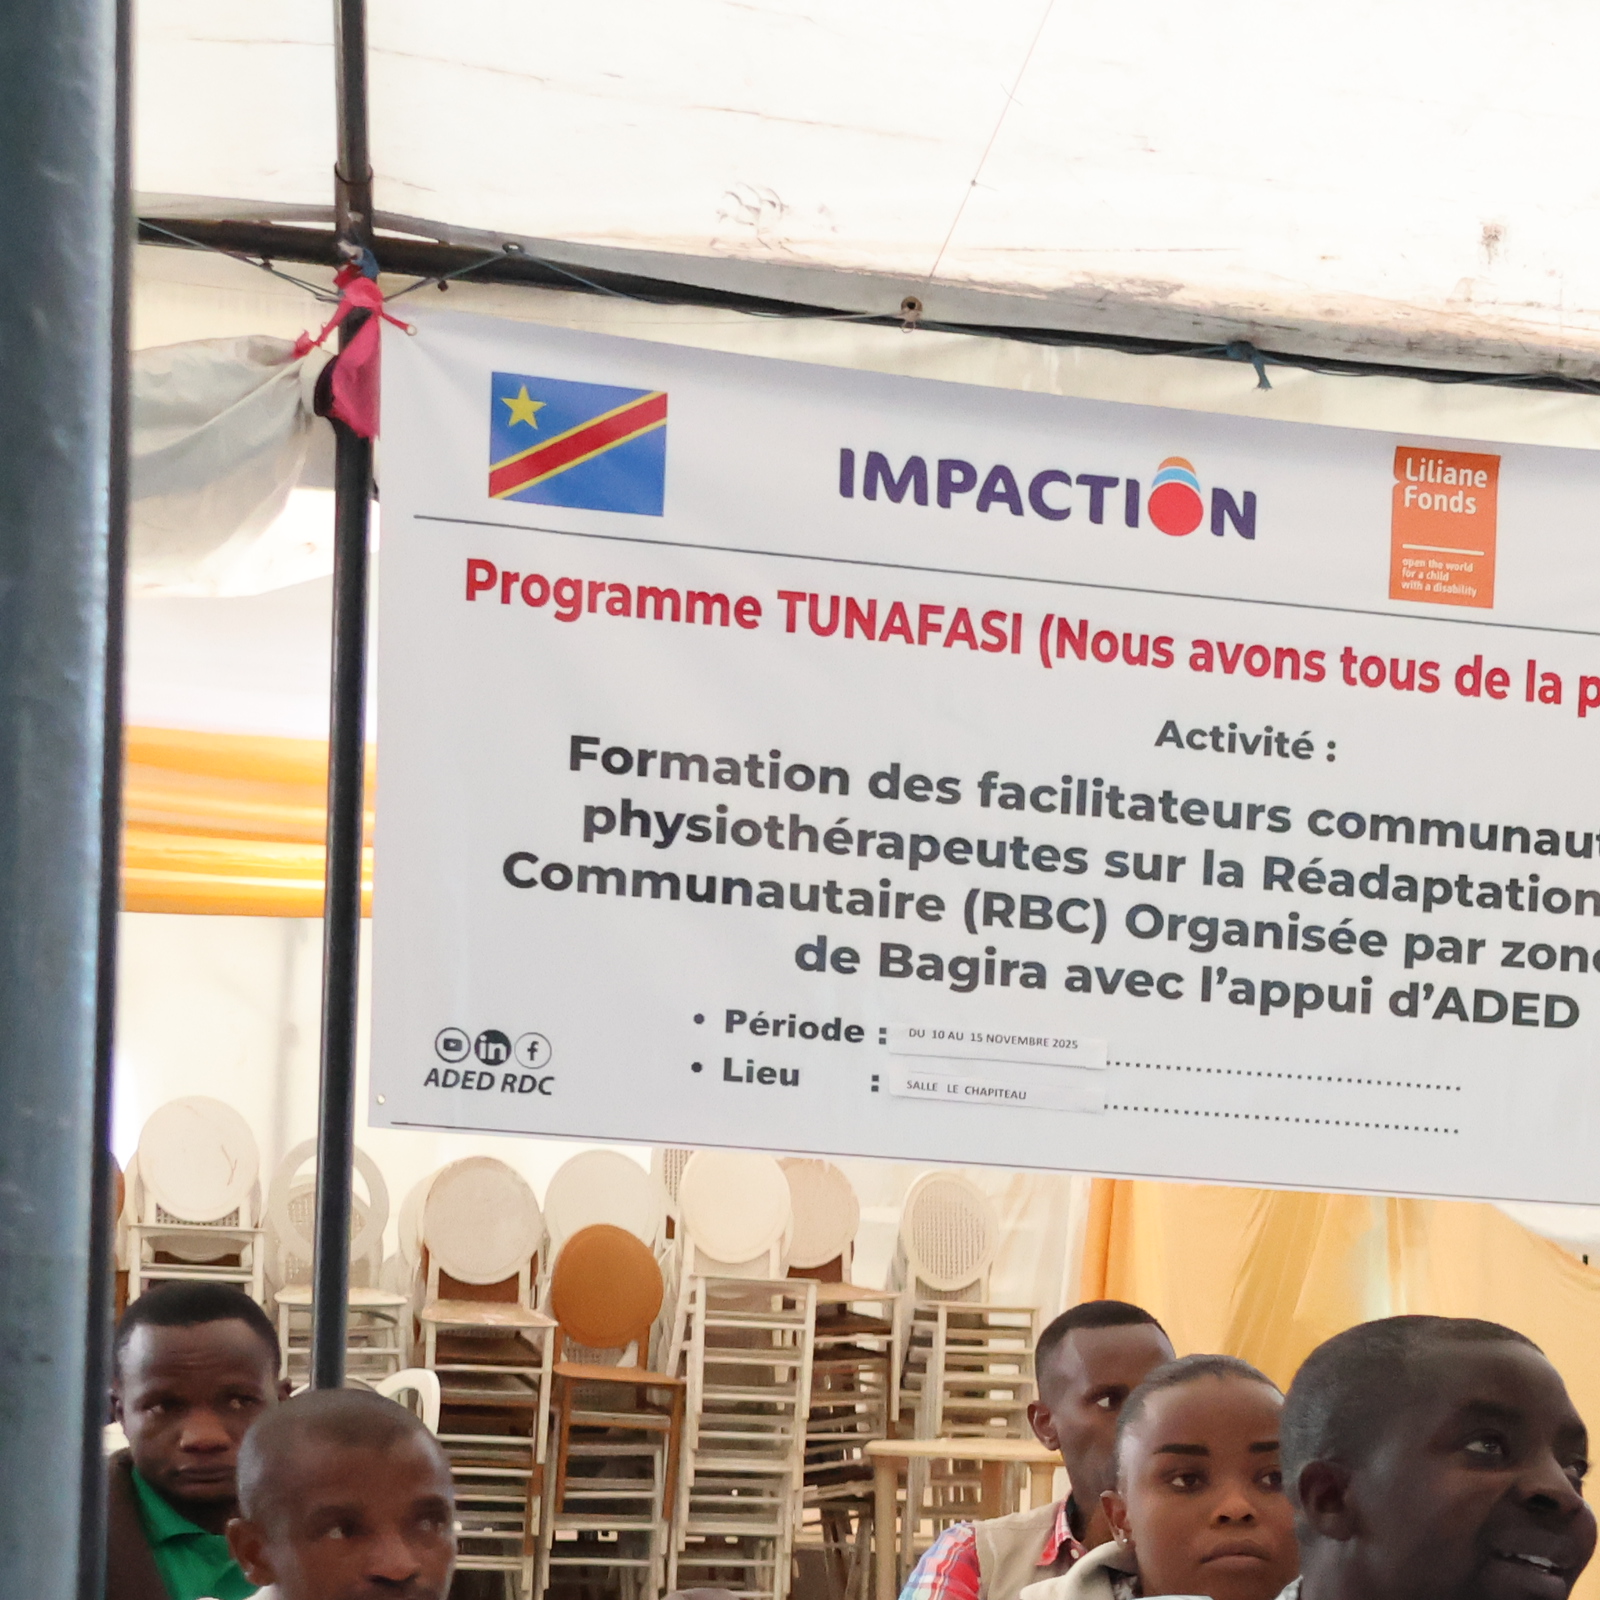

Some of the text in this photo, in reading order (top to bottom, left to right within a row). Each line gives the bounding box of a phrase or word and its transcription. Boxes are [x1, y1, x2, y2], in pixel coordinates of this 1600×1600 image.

[1405, 457, 1488, 488] Liliane
[839, 448, 1257, 540] IMPACTION
[1404, 485, 1477, 515] Fonds
[1401, 567, 1450, 582] for a child
[1402, 558, 1474, 573] open the world
[1401, 580, 1478, 598] with a disability
[465, 558, 762, 630] Programme
[777, 589, 1023, 655] TUNAFASI
[1039, 613, 1175, 669] (Nous
[1188, 638, 1326, 683] avons
[1340, 646, 1440, 693] tous
[1454, 655, 1511, 700] de
[1525, 659, 1563, 705] la
[1154, 720, 1315, 760] Activité
[569, 735, 850, 796] Formation
[868, 762, 962, 805] des
[977, 770, 1293, 834] facilitateurs
[583, 798, 1090, 875] physiothérapeutes
[1104, 849, 1188, 883] sur
[1202, 848, 1245, 889] la
[502, 851, 946, 923] Communautaire
[963, 887, 1107, 945] (RBC)
[1125, 902, 1389, 959] Organisée
[1403, 932, 1487, 970] par
[794, 934, 861, 975] de
[878, 941, 1048, 994] Bagira
[1063, 964, 1185, 1001] avec
[725, 1009, 866, 1044] Période
[908, 1027, 926, 1039] DU
[932, 1029, 946, 1040] 10
[947, 1030, 964, 1041] AU
[970, 1032, 984, 1043] 15
[986, 1033, 1050, 1048] NOVEMBRE
[1052, 1037, 1079, 1050] 2025
[423, 1067, 555, 1096] ADED RDC
[722, 1057, 800, 1087] Lieu
[906, 1079, 938, 1093] SALLE
[946, 1083, 959, 1094] LE
[964, 1084, 1027, 1100] CHAPITEAU
